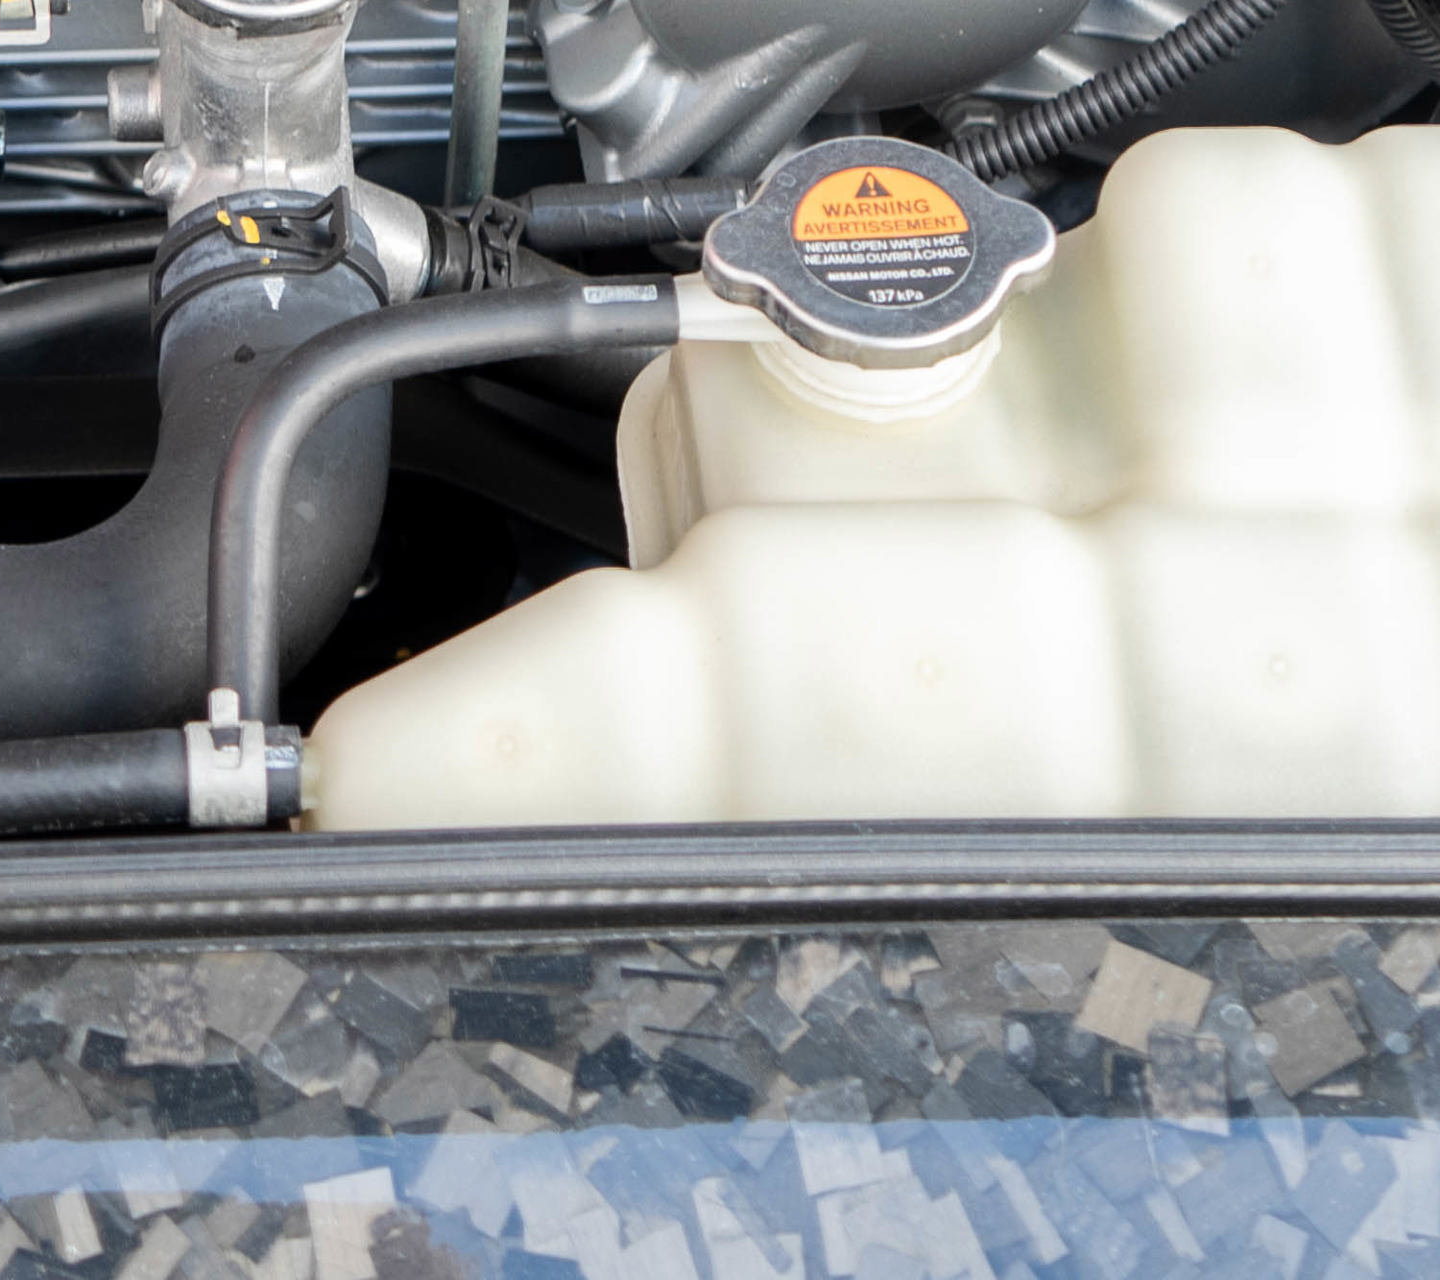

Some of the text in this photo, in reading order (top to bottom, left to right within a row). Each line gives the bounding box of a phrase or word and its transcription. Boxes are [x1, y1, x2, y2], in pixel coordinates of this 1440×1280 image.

[822, 197, 931, 217] WARNING
[803, 215, 959, 235] AVERTISSEMENT
[805, 235, 964, 253] NEVER OPEN WHEN HOT.
[822, 252, 865, 265] JAMAIS
[866, 250, 913, 264] OUVRIR
[924, 246, 970, 259] CHAUD.
[828, 270, 869, 282] NISSAN
[870, 268, 908, 281] MOTOR
[932, 267, 954, 278] LTD.
[868, 287, 924, 303] 137 kPa
